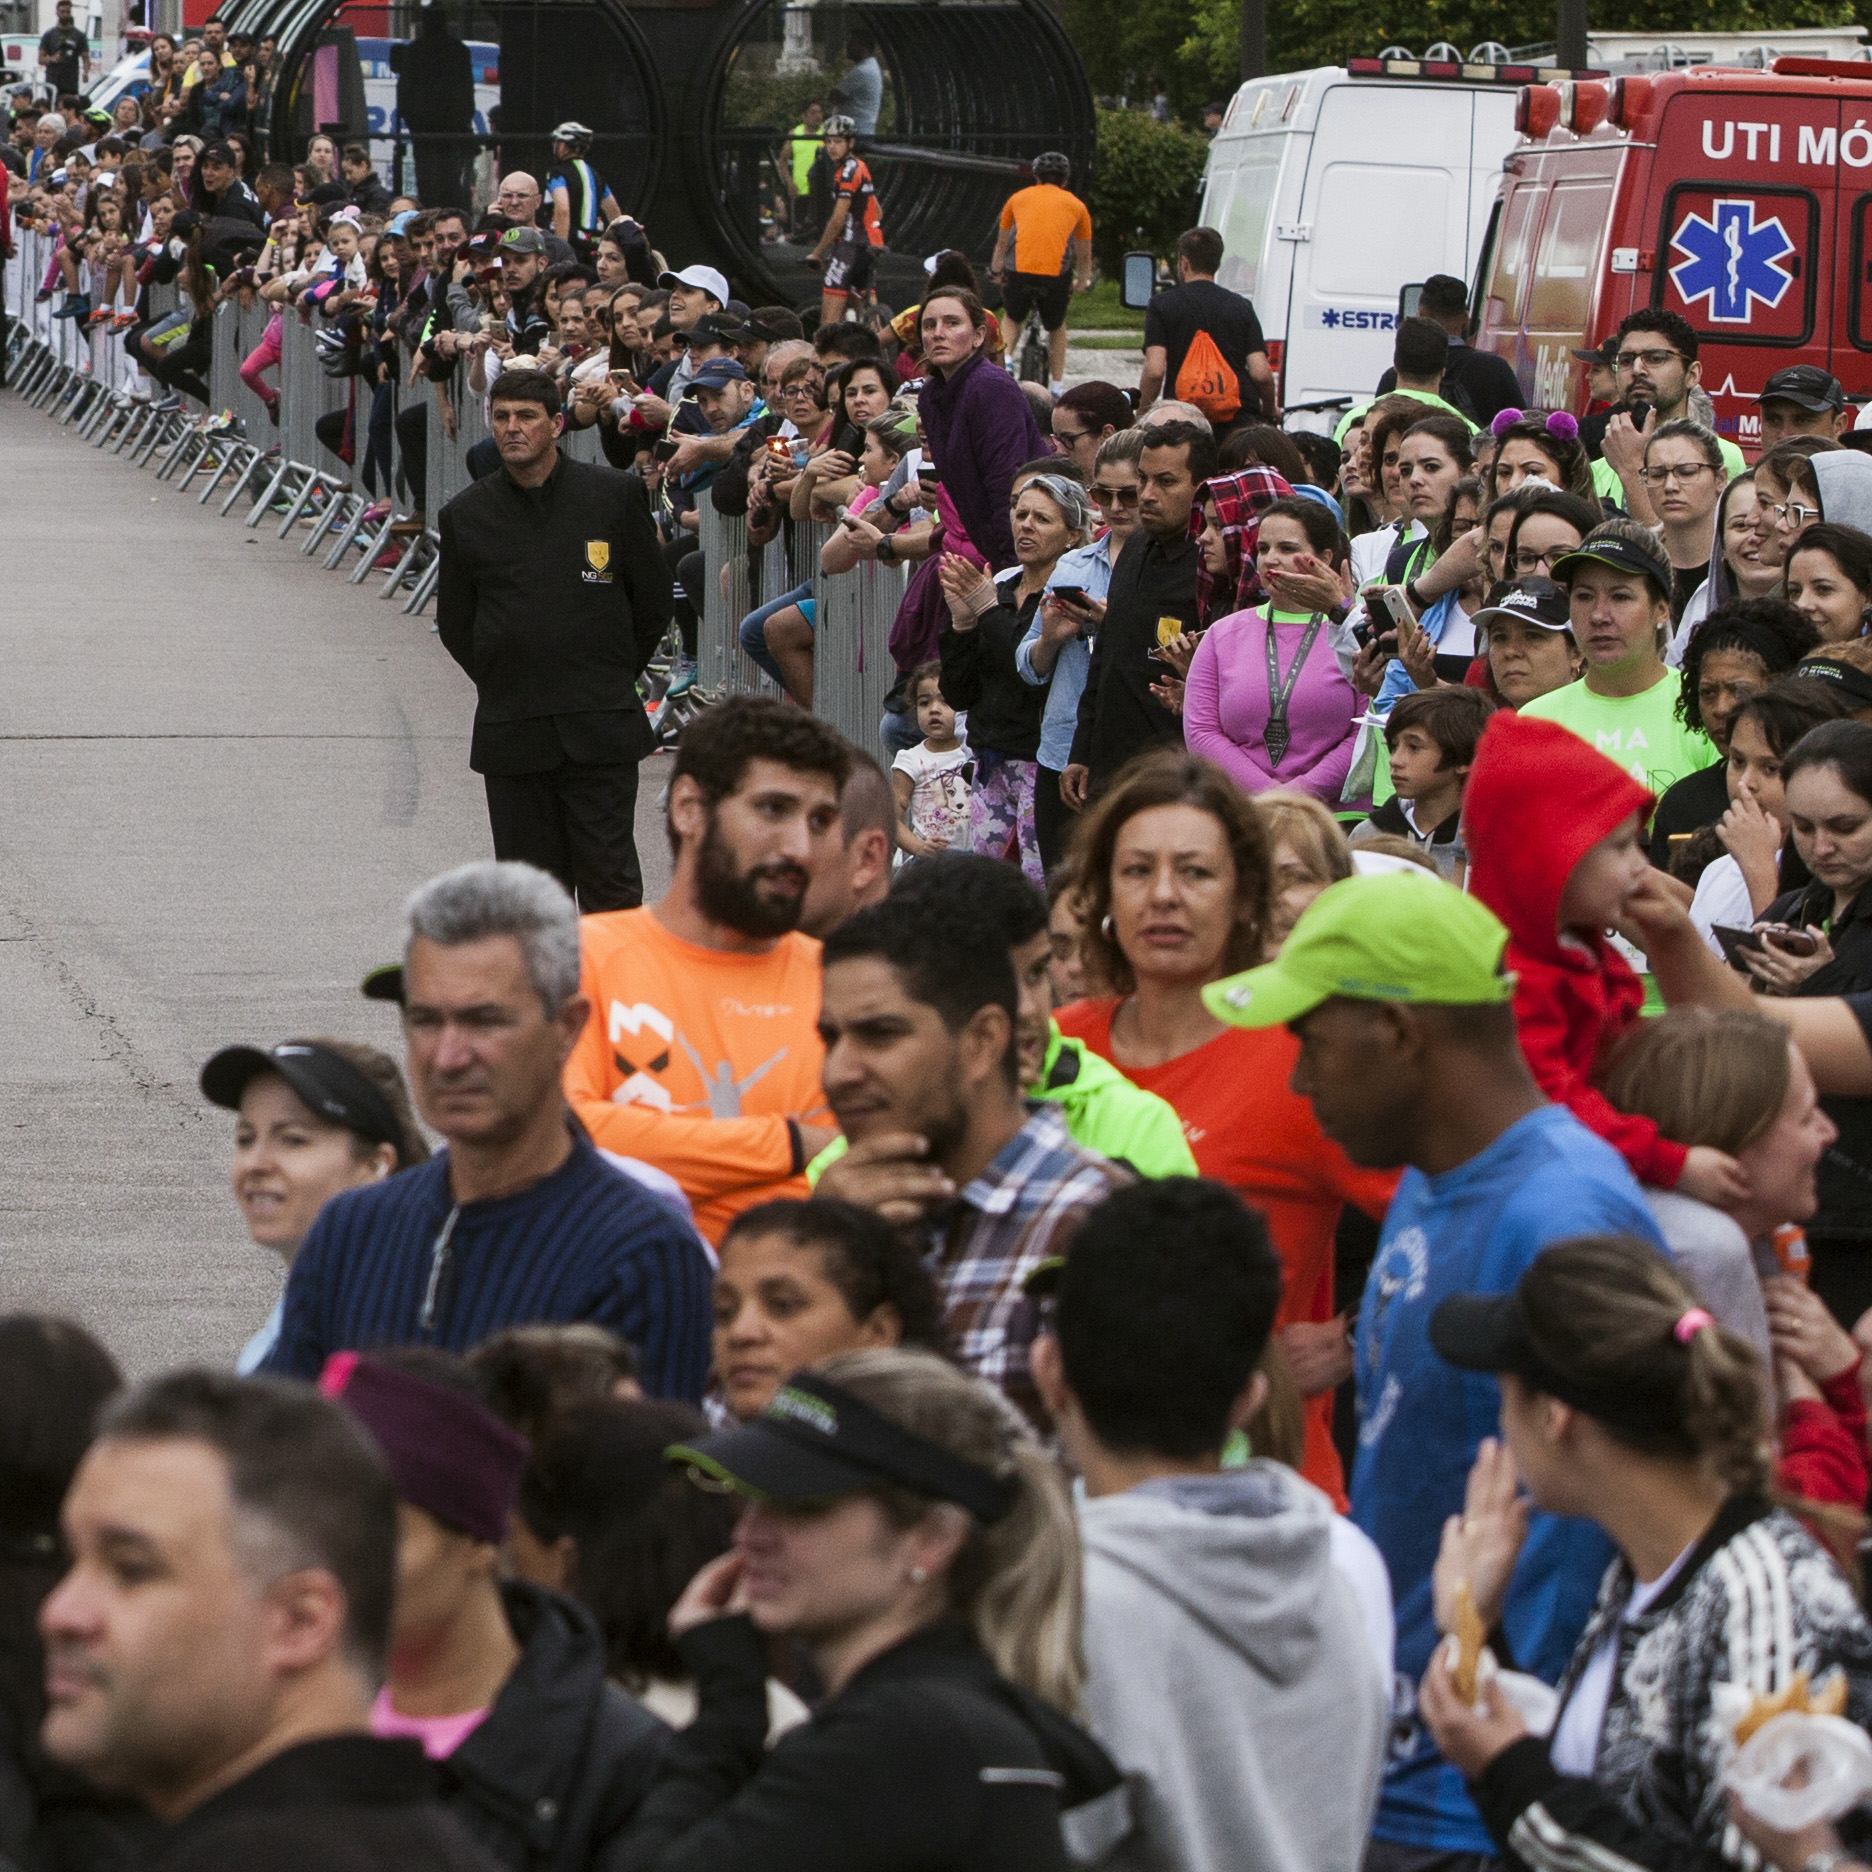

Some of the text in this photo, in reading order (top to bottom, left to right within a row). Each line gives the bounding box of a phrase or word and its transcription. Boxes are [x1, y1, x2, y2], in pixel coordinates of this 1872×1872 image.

[1702, 119, 1872, 168] UTI MÓ
[1343, 311, 1399, 330] ESTR
